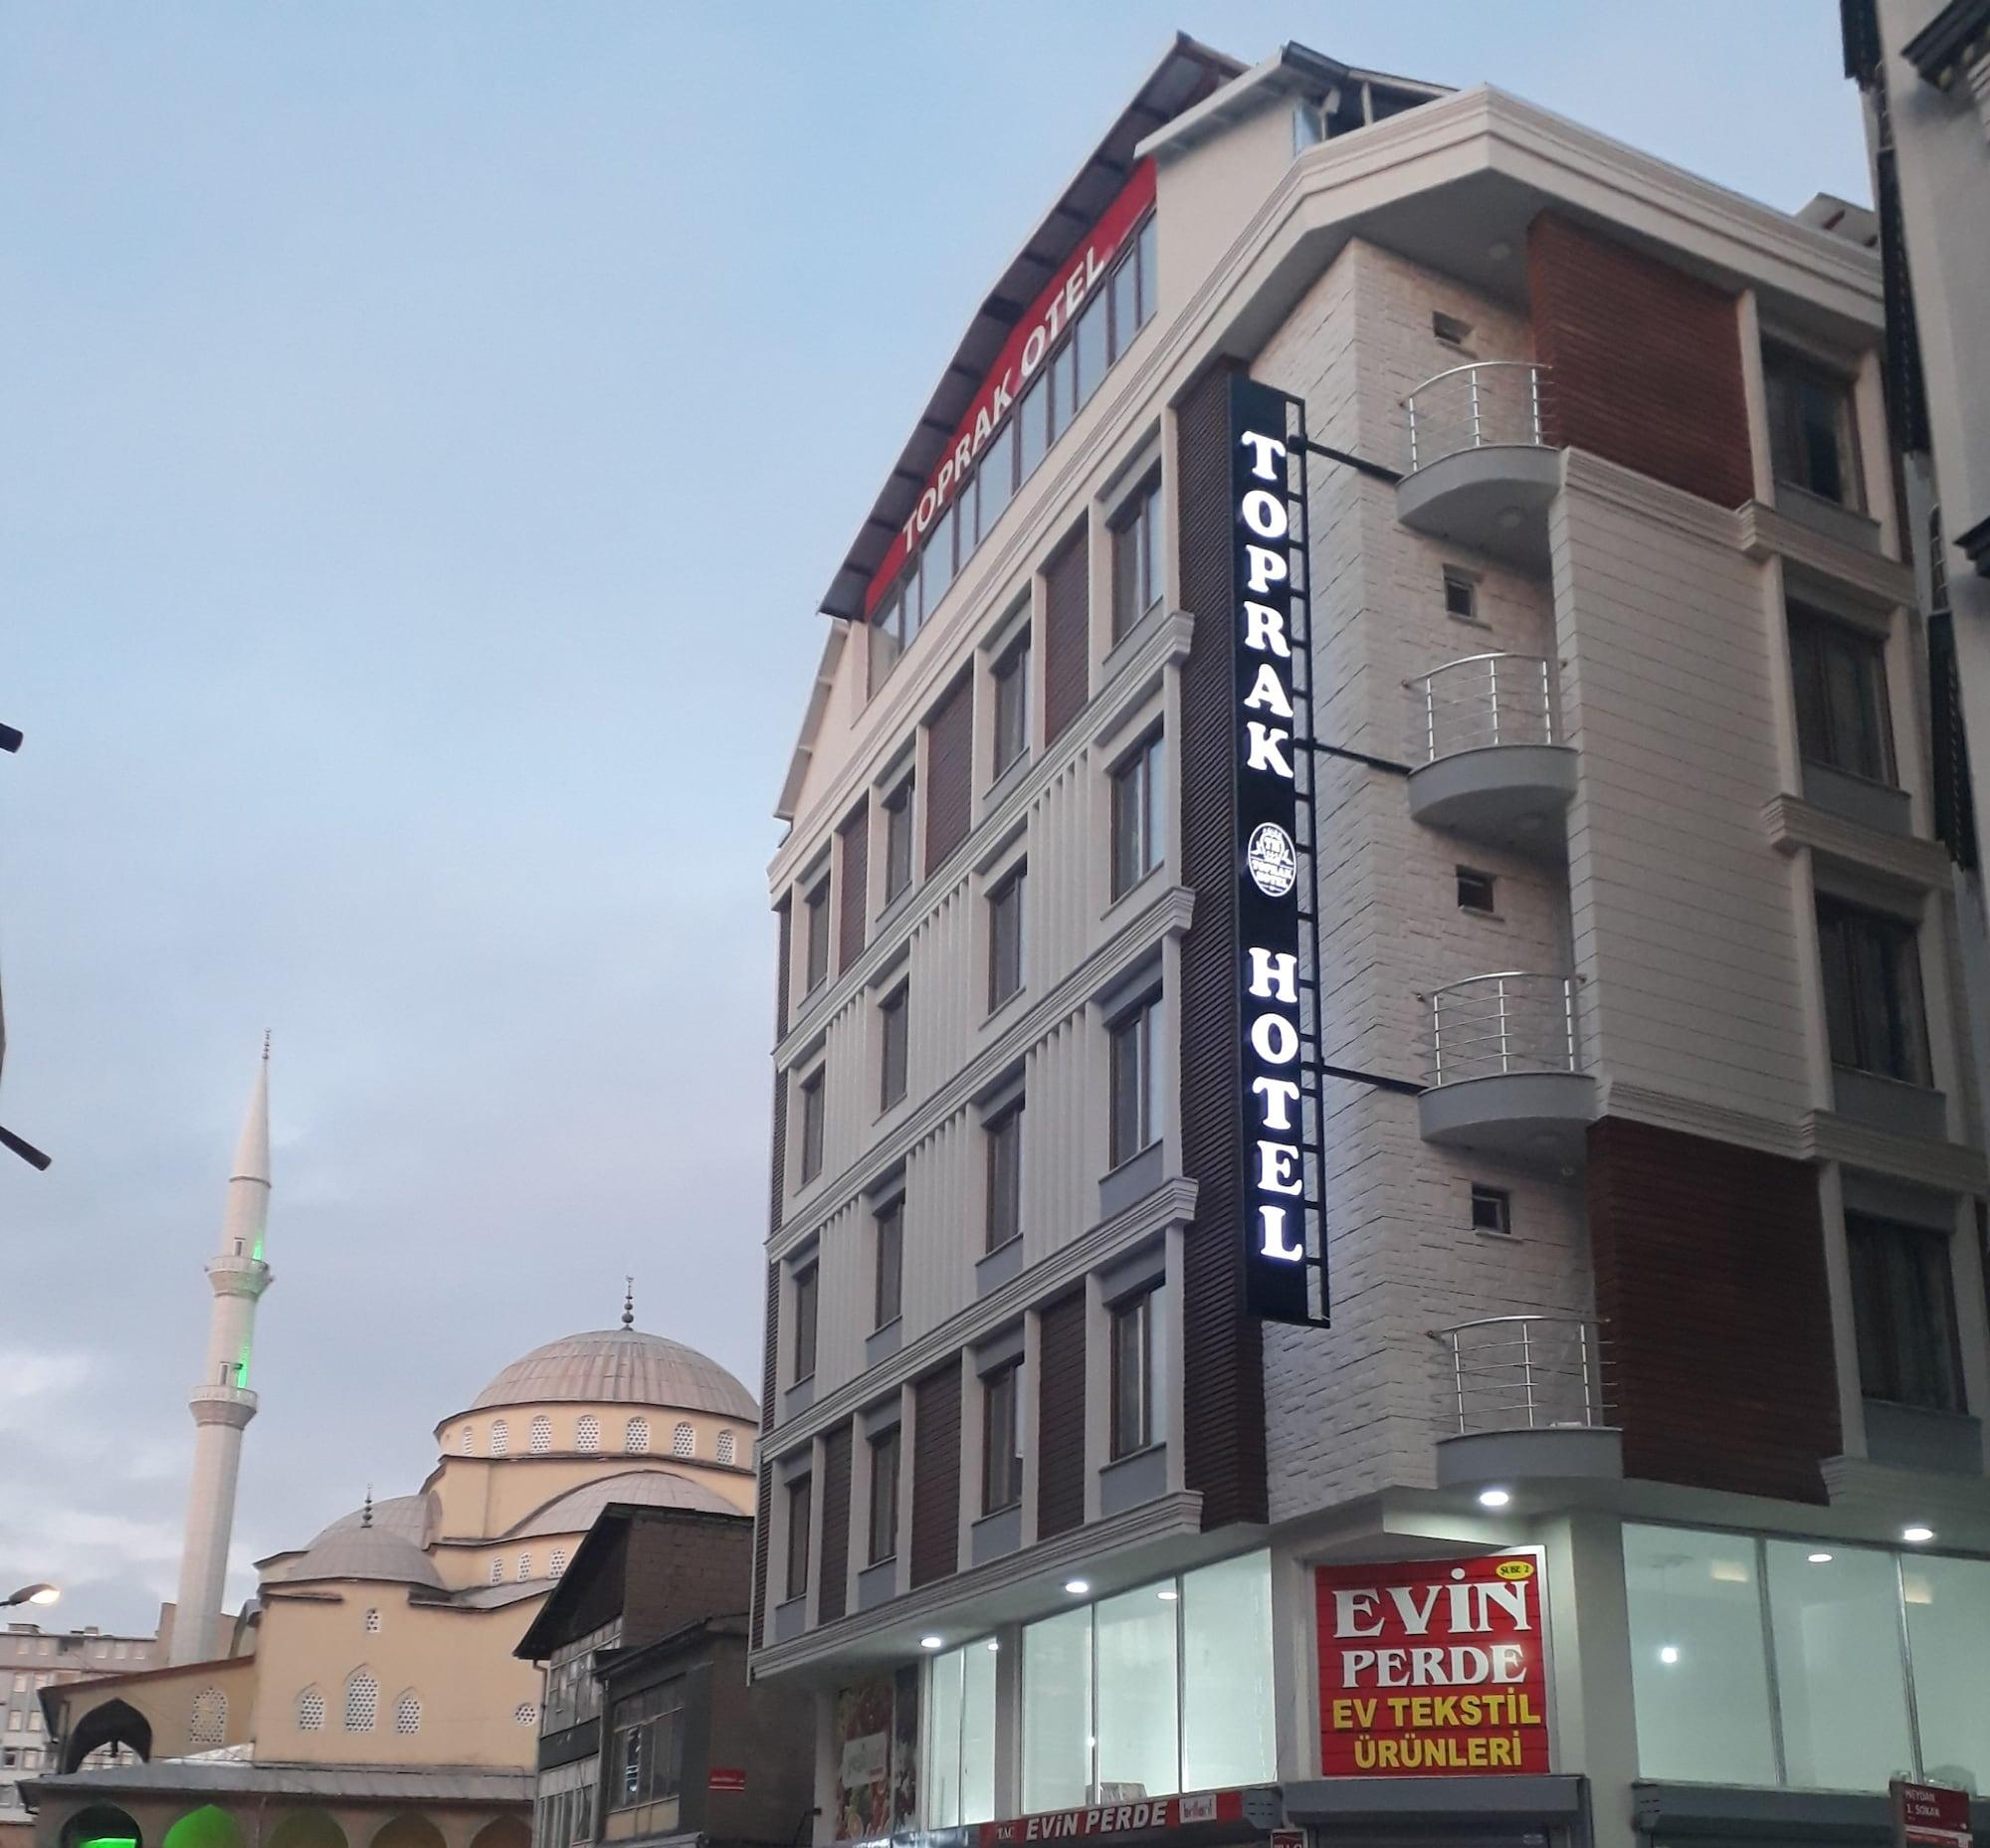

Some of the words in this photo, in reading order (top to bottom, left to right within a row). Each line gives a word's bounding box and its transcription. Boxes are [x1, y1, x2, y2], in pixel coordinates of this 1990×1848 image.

[901, 370, 1014, 553] TOPRAK
[1021, 245, 1105, 379] OTEL
[1241, 430, 1294, 779] TOPRAK
[1248, 946, 1303, 1263] HOTEL
[1331, 1567, 1532, 1638] EVİN
[1341, 1643, 1527, 1688] PERDE
[1332, 1698, 1377, 1729] EV
[1388, 1687, 1541, 1729] TEKSTİL
[1354, 1731, 1522, 1769] ÜRÜNLERİ
[1085, 1801, 1168, 1833] PERDE
